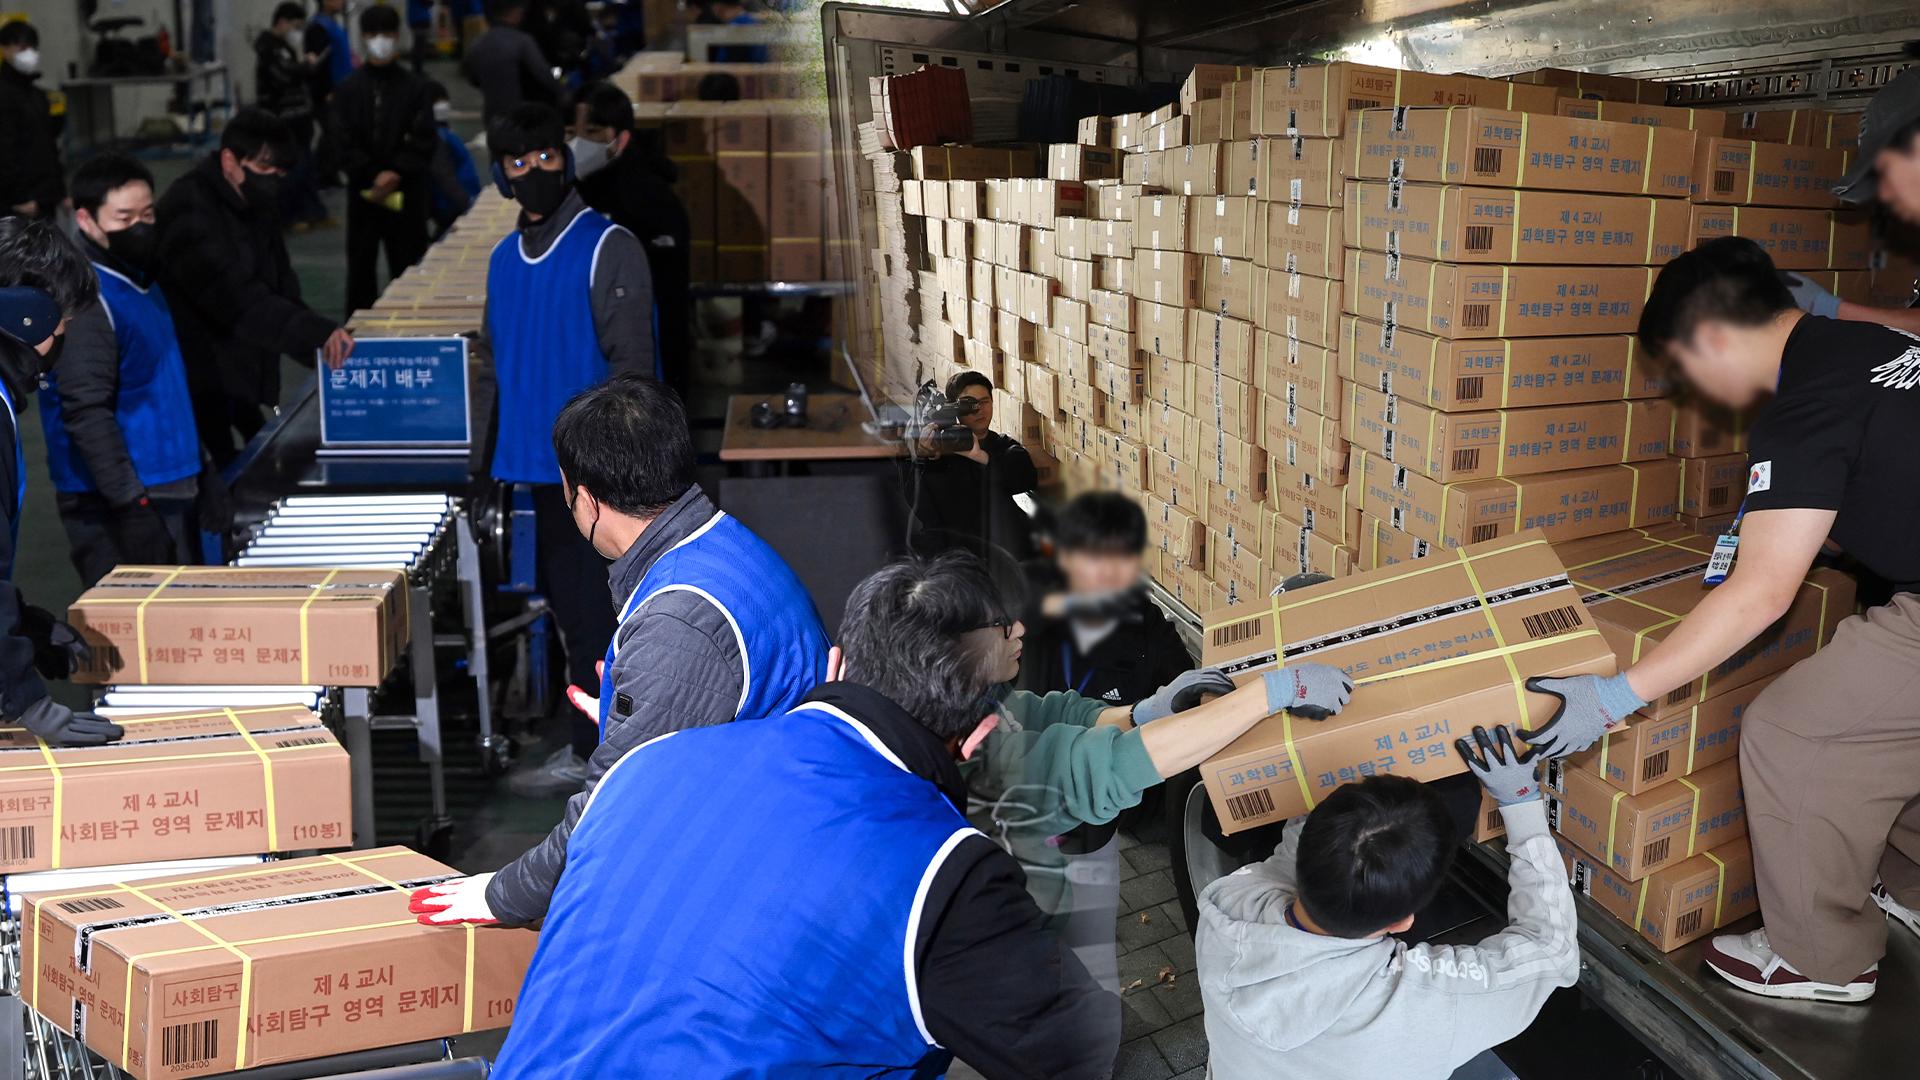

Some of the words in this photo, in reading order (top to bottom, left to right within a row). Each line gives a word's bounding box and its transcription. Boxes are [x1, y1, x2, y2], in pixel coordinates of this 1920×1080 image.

[1354, 76, 1393, 92] 사회탐구
[1483, 125, 1522, 142] 과학탐구
[1569, 135, 1579, 149] 제
[1582, 137, 1587, 148] 4
[1591, 138, 1610, 153] 교시
[1530, 152, 1576, 170] 과학탐구
[1582, 155, 1604, 173] 영역
[1609, 159, 1641, 176] 문제지
[1473, 203, 1514, 219] 과학탐구
[1560, 209, 1570, 224] 제
[1573, 210, 1579, 224] 4
[1582, 211, 1602, 226] 교시
[1521, 228, 1568, 246] 과학탐구
[1574, 230, 1597, 246] 영역
[1602, 231, 1634, 247] 문제지
[1557, 284, 1567, 297] 제
[1570, 285, 1576, 296] 4
[1579, 284, 1599, 299] 교시
[1519, 303, 1565, 318] 과학탐구
[1570, 302, 1592, 317] 영역
[1599, 301, 1631, 316] 문제지
[1464, 355, 1504, 370] 과학탐구
[1549, 354, 1559, 368] 제
[1562, 355, 1568, 366] 4
[1571, 353, 1591, 367] 교시
[330, 368, 387, 389] 문제지
[395, 367, 434, 389] 배부
[1512, 372, 1557, 389] 과학탐구
[1563, 372, 1585, 386] 영역
[1591, 369, 1623, 385] 문제지
[1460, 426, 1500, 441] 과학탐구
[1545, 423, 1555, 436] 제
[1558, 423, 1564, 434] 4
[1568, 421, 1587, 434] 교시
[1508, 441, 1552, 459] 과학탐구
[1559, 439, 1580, 454] 영역
[1586, 435, 1618, 450] 문제지
[1560, 494, 1569, 507] 제
[1572, 494, 1577, 504] 4
[1581, 489, 1600, 504] 교시
[1480, 501, 1518, 516] 과학탐구
[1524, 512, 1568, 530] 과학탐구
[1572, 508, 1593, 523] 영역
[1599, 502, 1629, 517] 문제지
[190, 627, 204, 641] 제
[208, 627, 217, 640] 4
[222, 626, 252, 642] 교시
[212, 646, 246, 664] 영역
[1375, 734, 1393, 751] 제
[1399, 730, 1409, 744] 4
[1415, 719, 1452, 742] 교시
[1650, 722, 1689, 745] 과학탐구
[1696, 724, 1740, 753] 과학탐구
[1229, 759, 1294, 787] 과학탐구
[1318, 755, 1397, 788] 과학탐구
[1407, 740, 1448, 766] 영역
[123, 793, 140, 812] 제
[146, 793, 156, 810] 4
[163, 788, 200, 808] 교시
[60, 819, 140, 843] 사회탐구
[152, 814, 192, 837] 영역
[204, 807, 265, 833] 문제지
[1652, 807, 1691, 833] 과학탐구
[1699, 805, 1745, 836] 과학탐구
[43, 963, 75, 997] 사회탐구
[313, 973, 332, 996] 제
[338, 972, 350, 990] 4
[355, 965, 395, 989] 교시
[172, 982, 239, 1007] 사회탐구
[246, 1004, 331, 1038] 사회탐구
[343, 995, 384, 1023] 영역
[398, 983, 460, 1014] 문제지
[170, 1060, 210, 1073] 20264100
